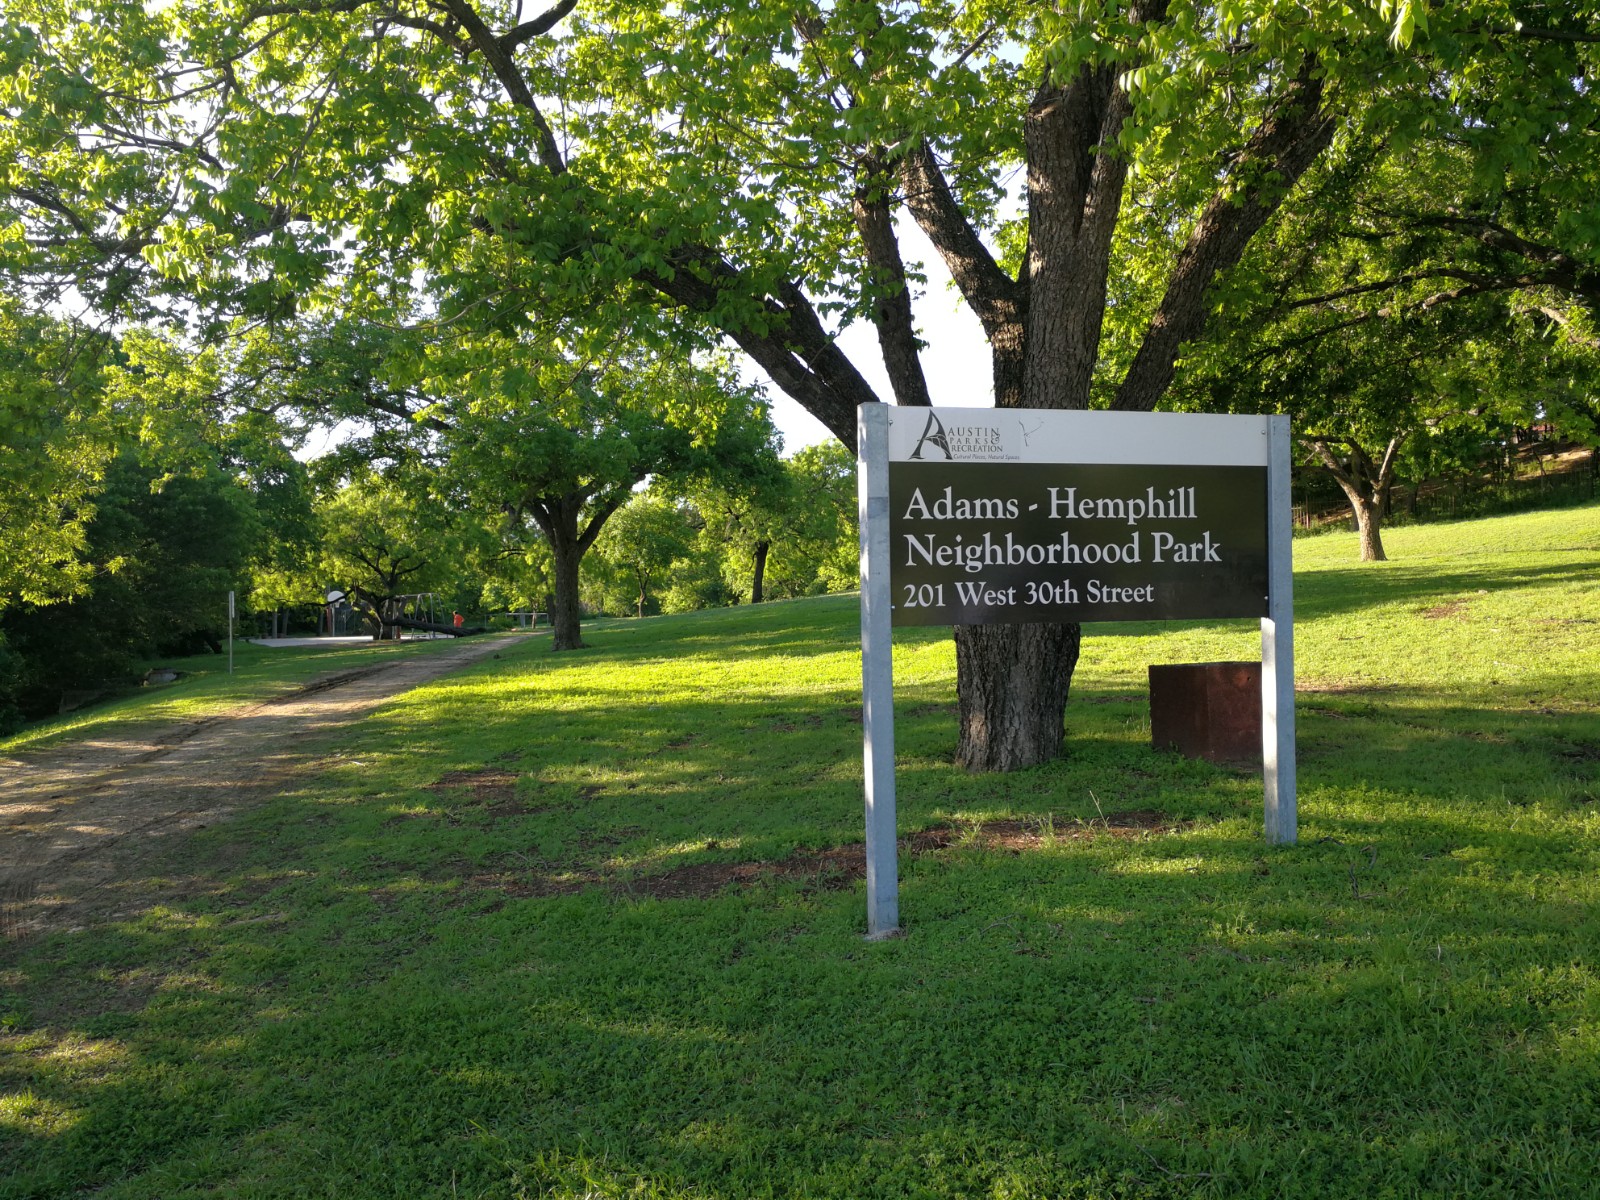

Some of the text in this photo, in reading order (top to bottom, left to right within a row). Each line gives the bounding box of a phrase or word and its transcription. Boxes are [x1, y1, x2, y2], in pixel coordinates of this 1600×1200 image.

[947, 427, 1000, 437] AUSTIN
[951, 444, 1003, 452] RECREATION
[903, 486, 1019, 520] Adams
[1047, 486, 1198, 526] Hemphill
[903, 531, 1222, 572] Neighborhood Park
[903, 579, 1154, 607] 201 West 30th Street
